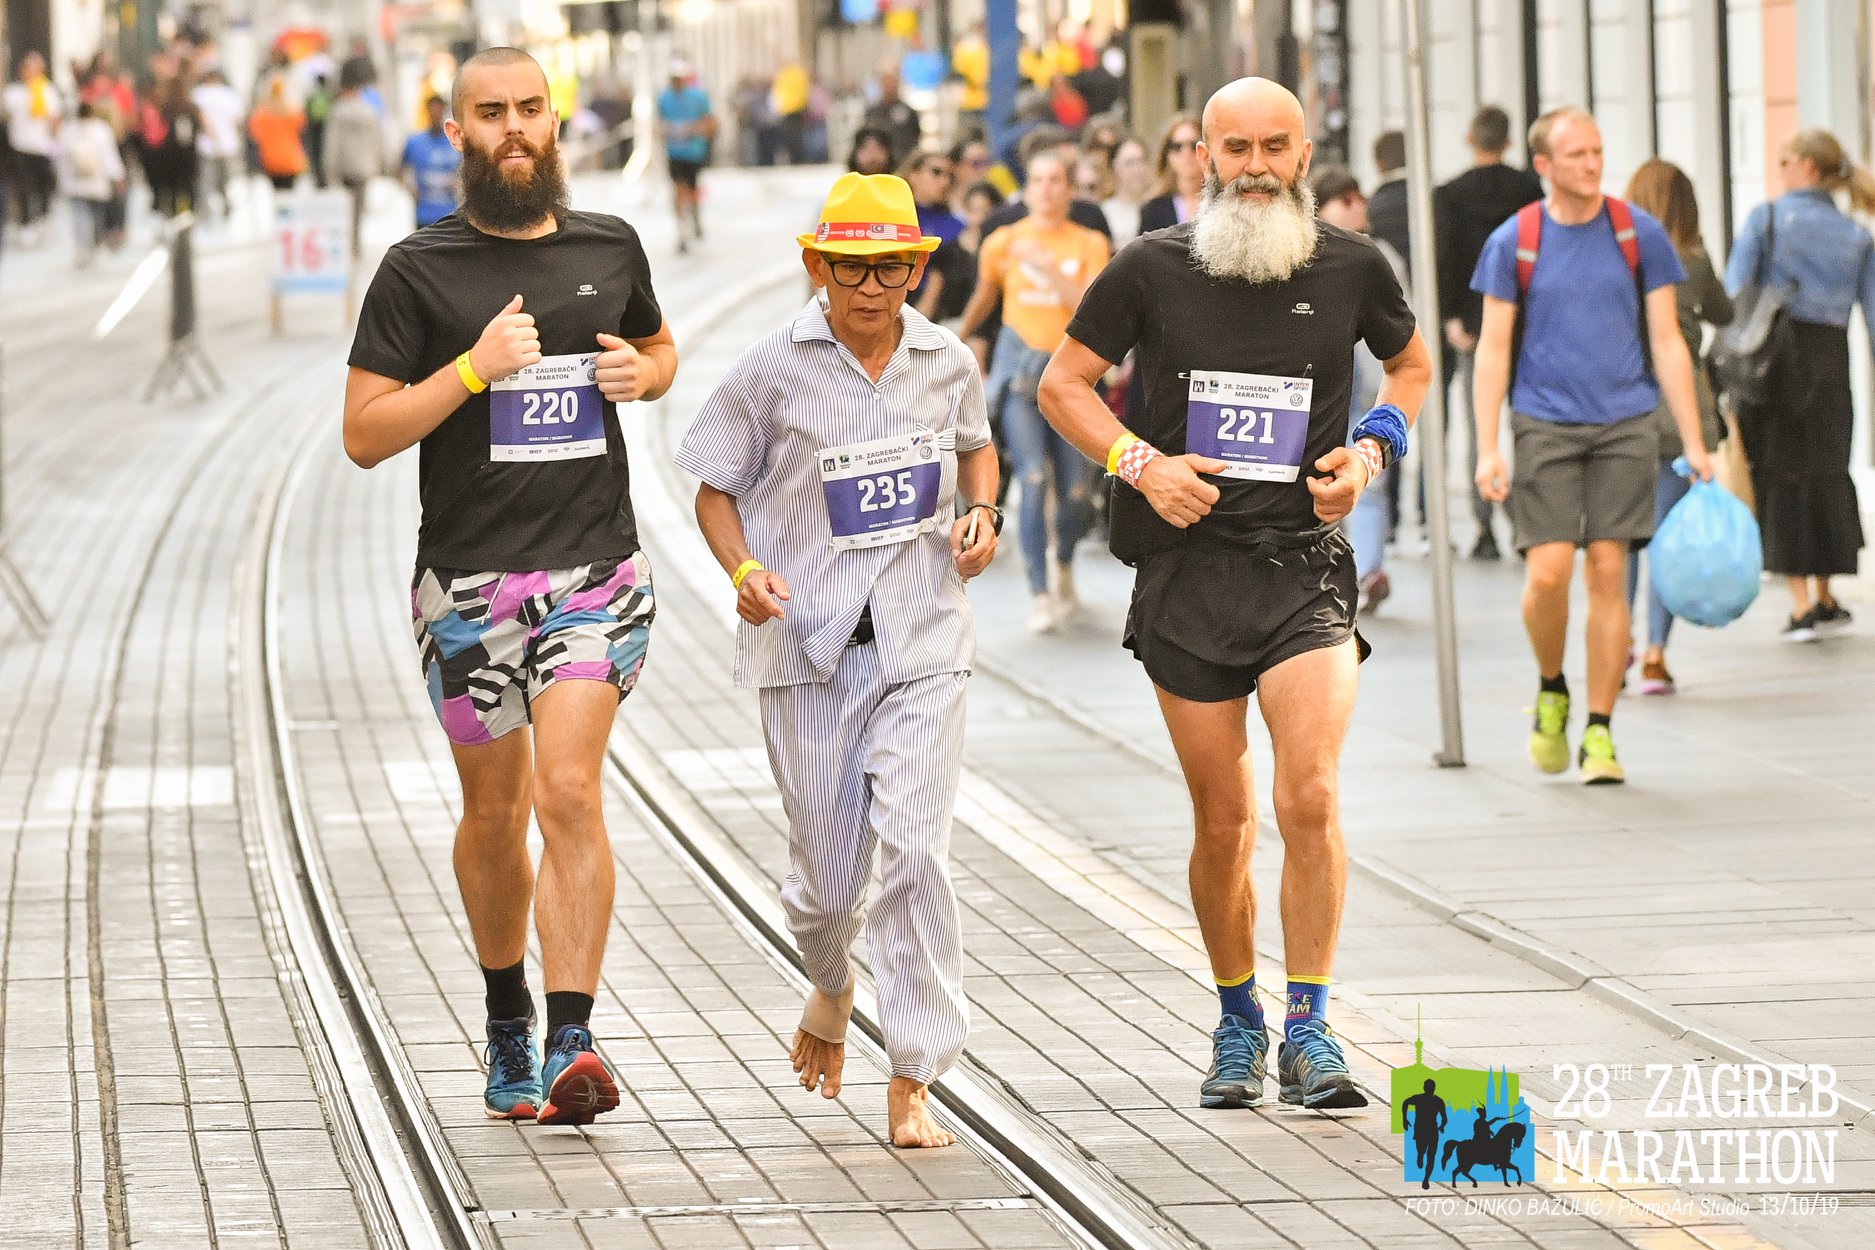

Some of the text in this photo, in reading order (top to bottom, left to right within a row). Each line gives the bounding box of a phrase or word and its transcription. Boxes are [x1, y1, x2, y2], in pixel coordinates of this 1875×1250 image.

[279, 228, 326, 273] 16
[535, 365, 577, 373] ZAGREBAČKI
[1235, 384, 1279, 393] ZAGREBAČKI
[1235, 392, 1270, 400] MARATON
[522, 390, 579, 425] 220
[1217, 408, 1275, 444] 221
[866, 445, 909, 459] ZAGREBAČKI
[867, 455, 902, 466] MARATON
[857, 471, 917, 513] 235
